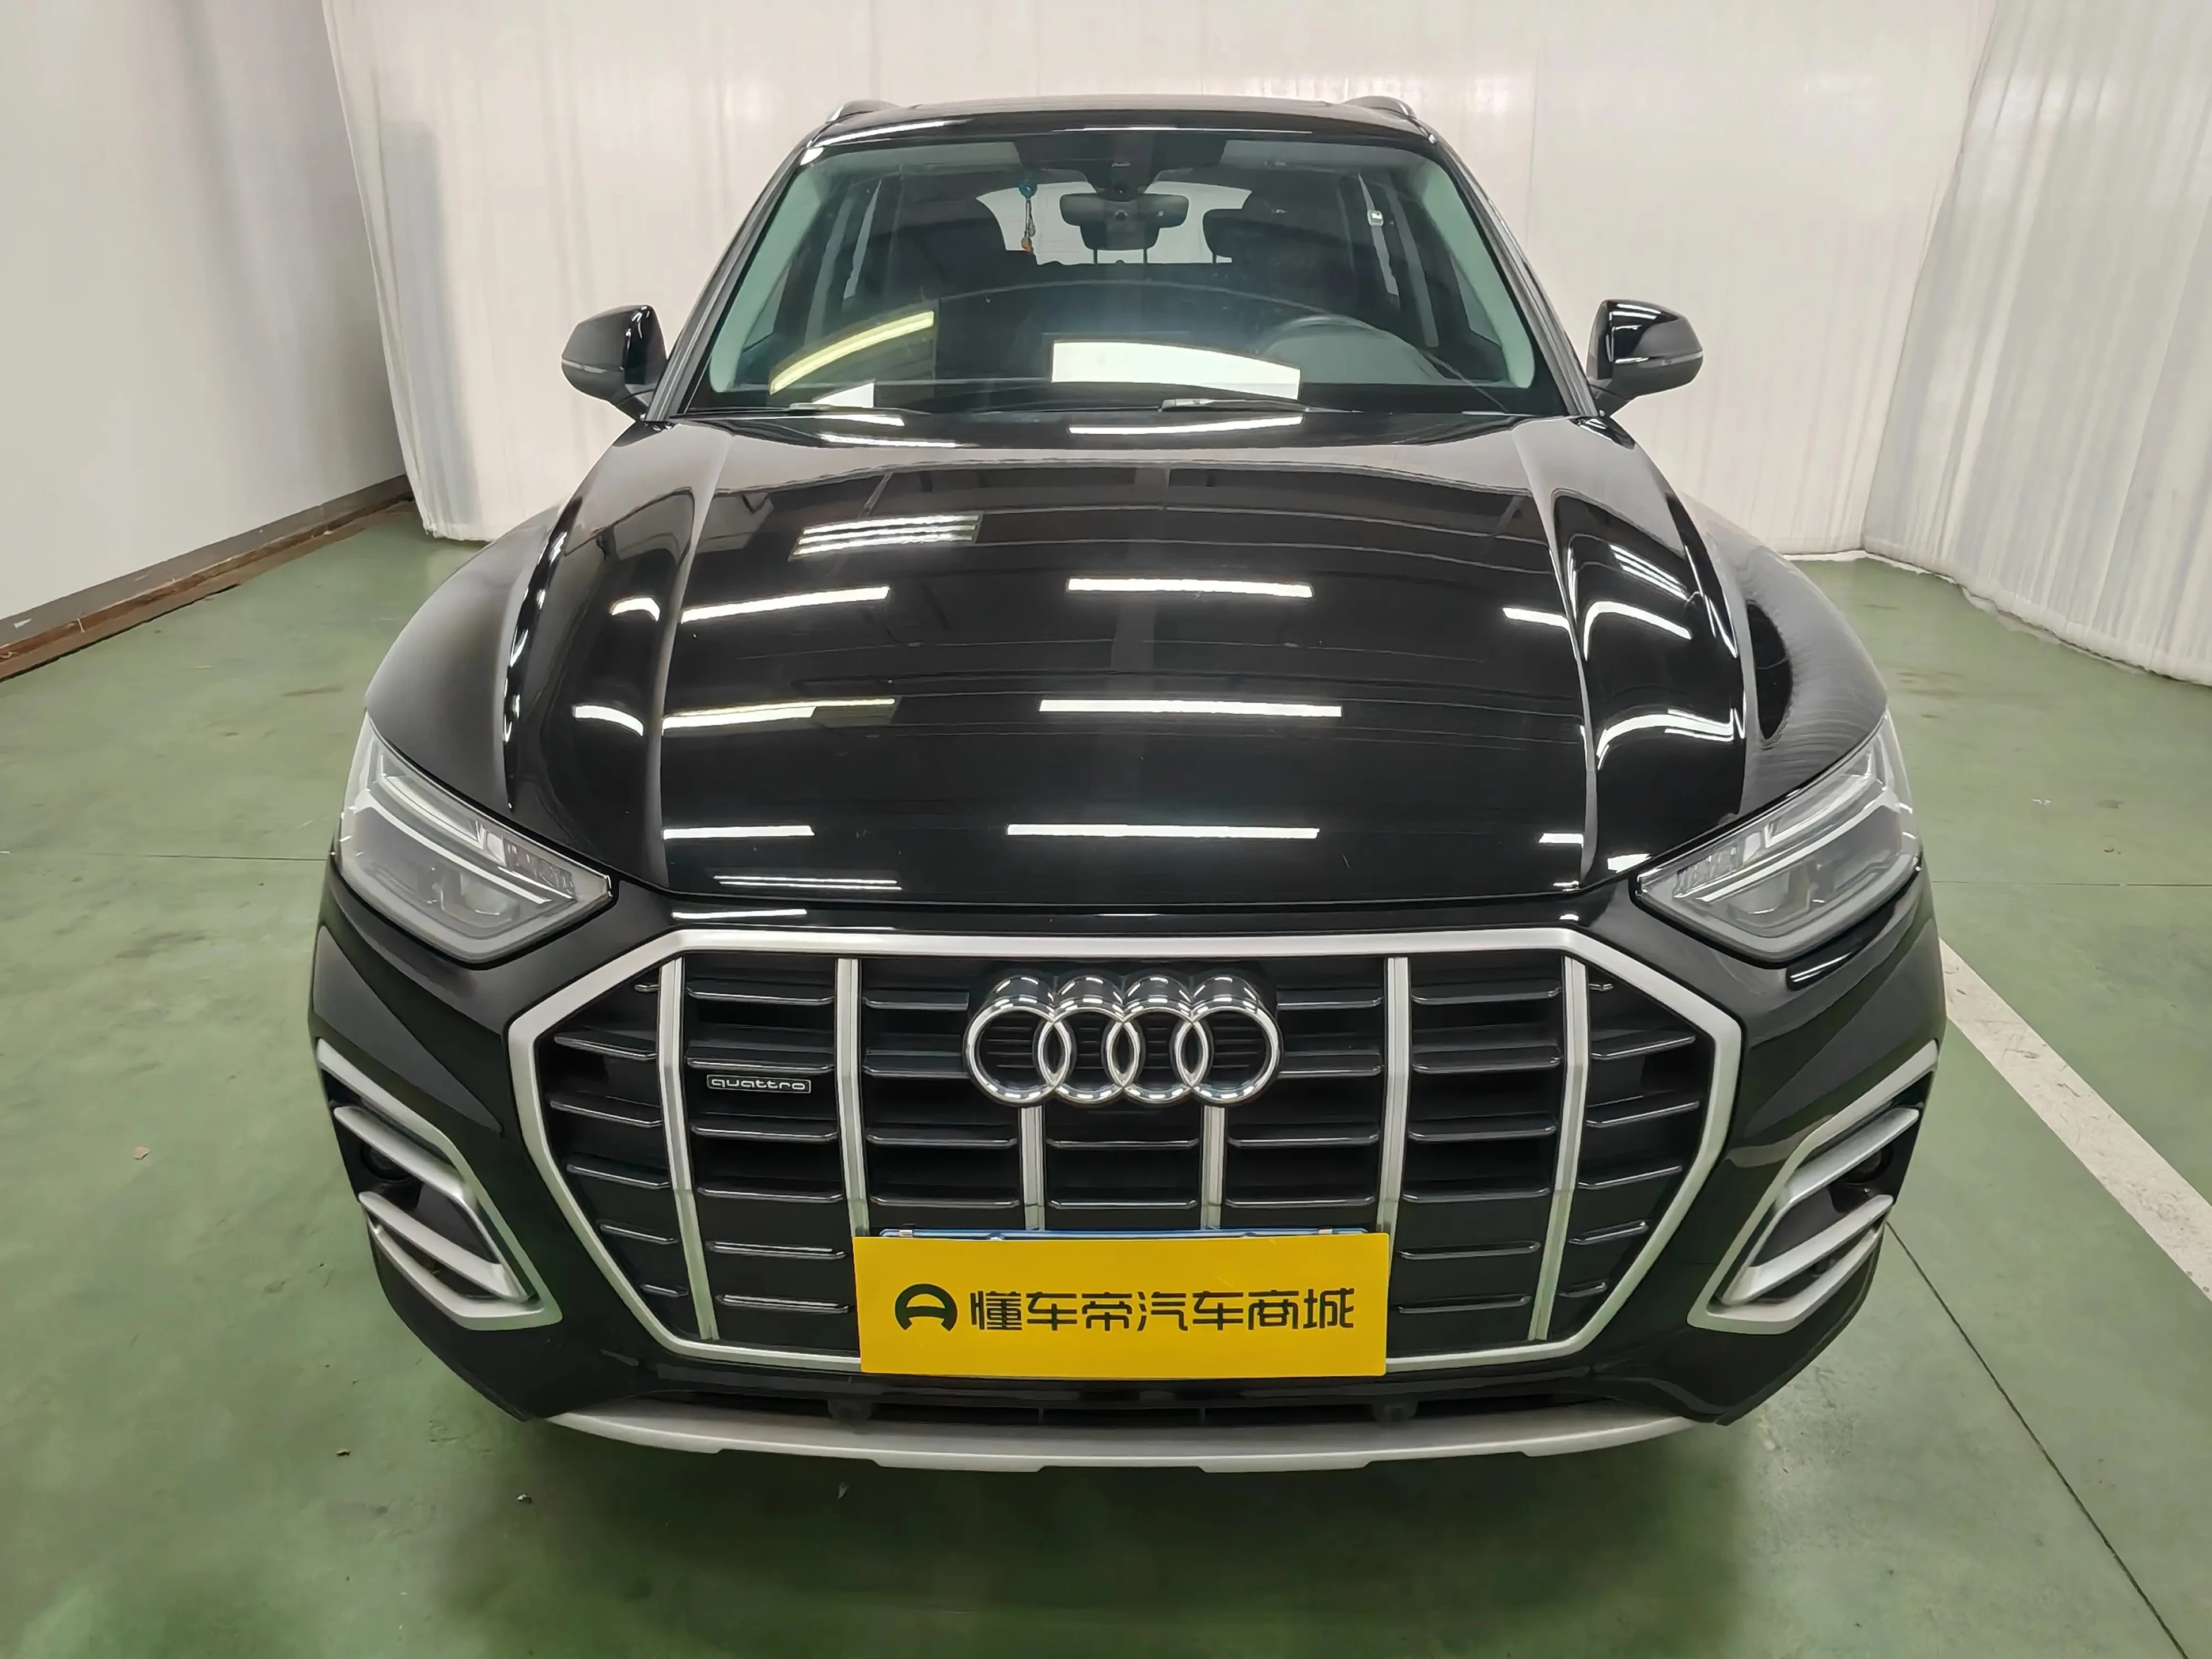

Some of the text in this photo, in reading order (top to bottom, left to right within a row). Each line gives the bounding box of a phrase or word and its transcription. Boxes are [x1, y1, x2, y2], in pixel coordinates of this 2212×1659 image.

[711, 1078, 806, 1090] quattro
[969, 1287, 1355, 1331] 懂车帝汽车商城
